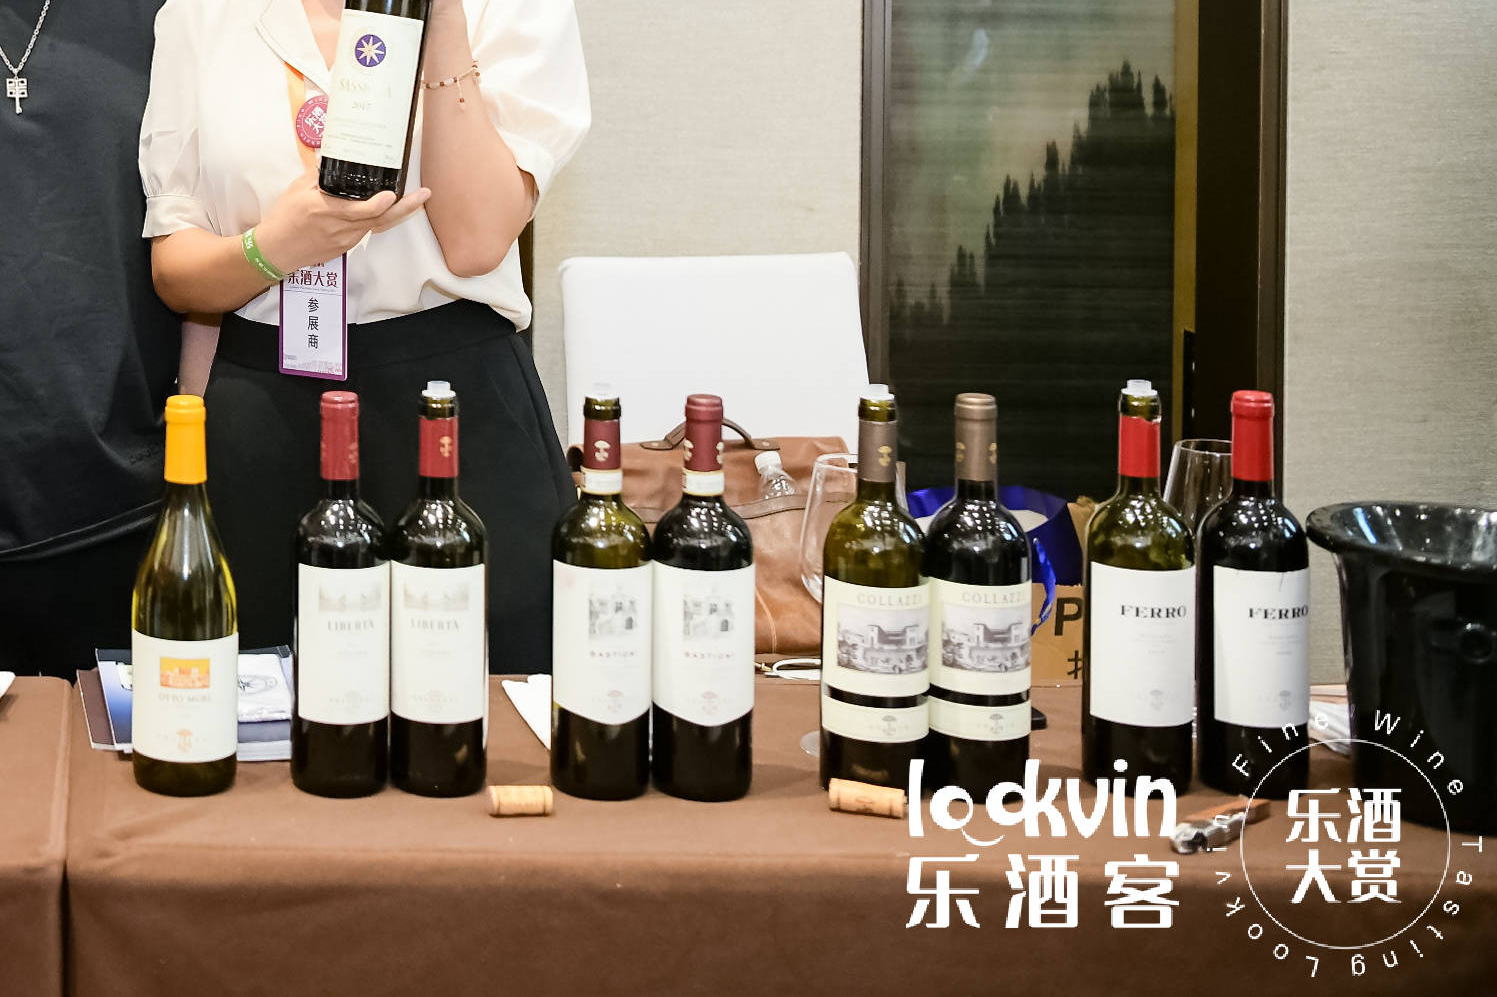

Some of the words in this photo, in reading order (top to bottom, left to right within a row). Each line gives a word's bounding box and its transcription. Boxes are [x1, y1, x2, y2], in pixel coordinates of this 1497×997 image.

[307, 297, 319, 349] 参展商
[1120, 604, 1187, 619] FERRO
[1247, 604, 1310, 621] FERRO
